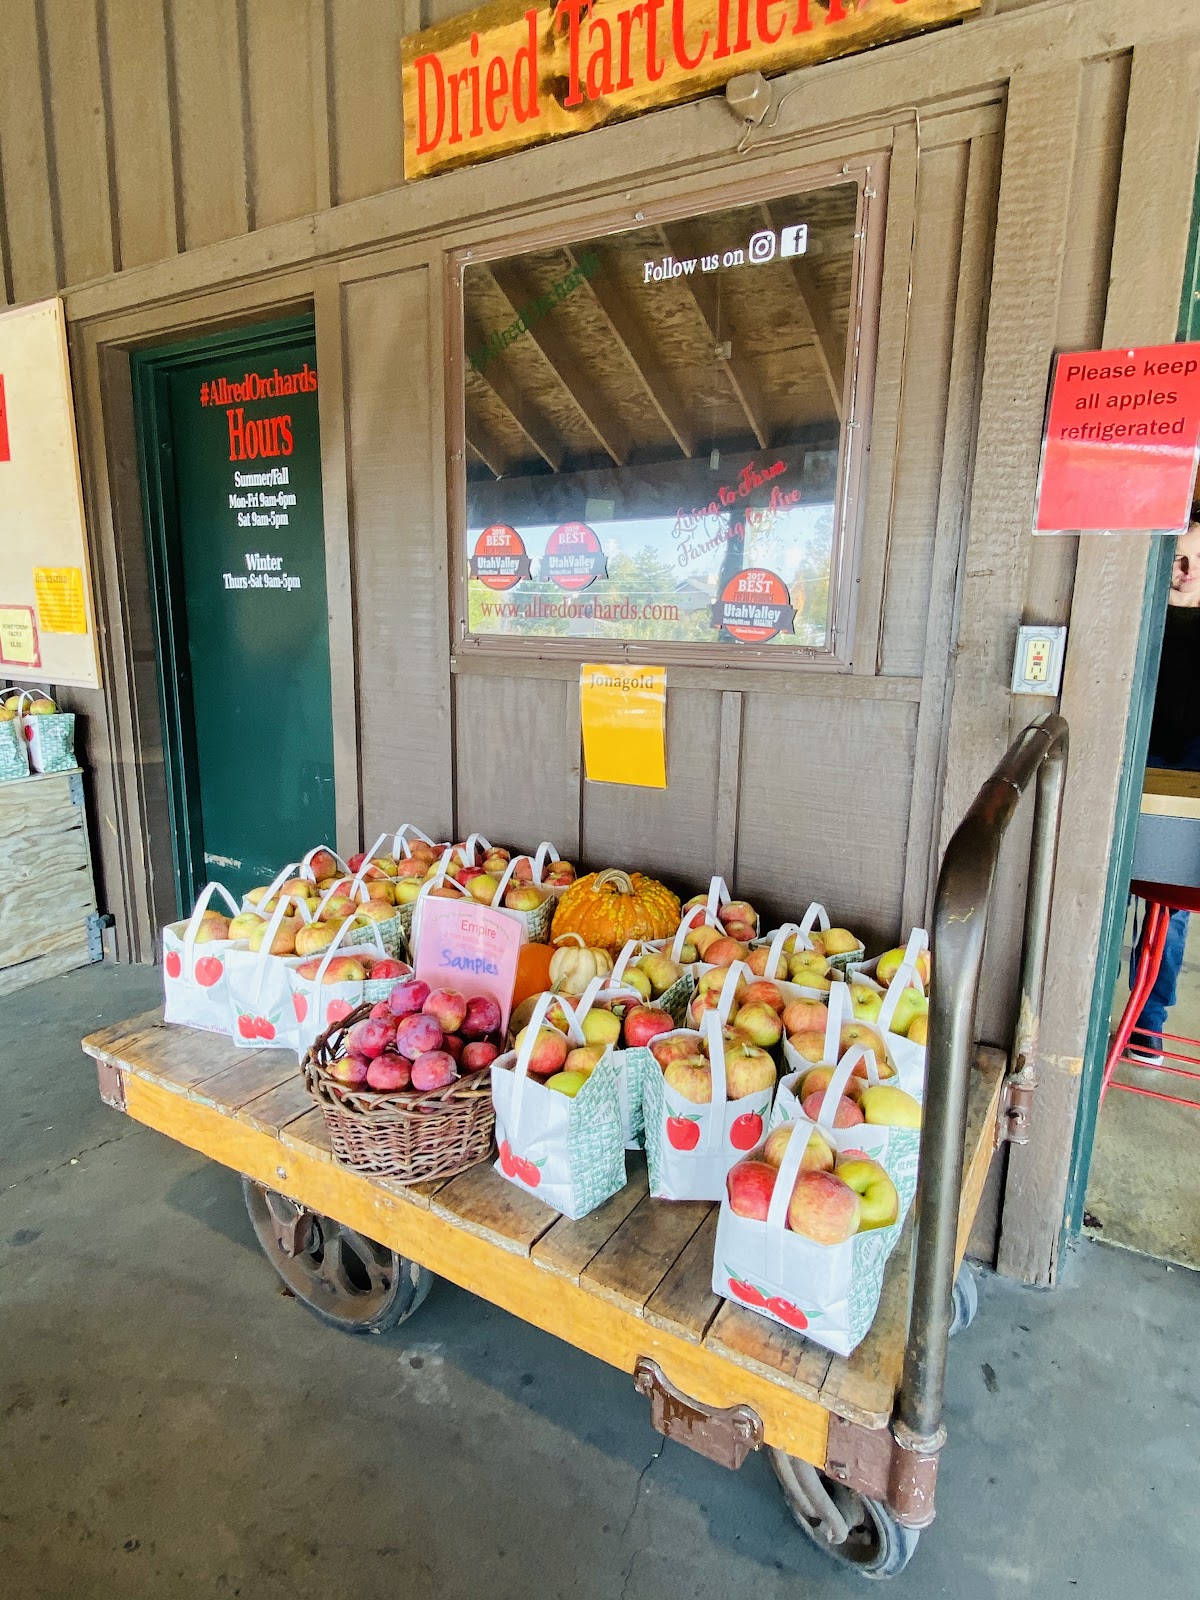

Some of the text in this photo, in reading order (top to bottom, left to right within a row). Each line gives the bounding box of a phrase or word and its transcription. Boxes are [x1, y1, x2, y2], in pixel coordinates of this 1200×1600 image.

[416, 9, 539, 156] Dried
[558, 0, 665, 107] Tart
[644, 257, 697, 283] Follow
[702, 254, 718, 271] us
[724, 249, 744, 267] on
[1067, 359, 1198, 381] Please keep
[201, 363, 317, 407] #AllredOrchards
[1076, 389, 1177, 410] all apples
[227, 408, 293, 461] Hours
[1061, 417, 1185, 441] refrigerated
[235, 467, 289, 487] Summer/Fall
[718, 486, 737, 506] to
[739, 460, 787, 497] Farm
[229, 491, 297, 509] Mon-Fri 9am-6pm
[238, 511, 289, 529] Sat 9am-5pm
[485, 534, 513, 547] BEST
[558, 531, 587, 544] BEST
[678, 522, 745, 567] Farming
[745, 507, 764, 526] to
[245, 553, 283, 571] Winter
[478, 557, 520, 571] UtahValley
[549, 556, 595, 569] UtahValley
[264, 573, 301, 592] 9am-5pm
[738, 580, 773, 593] BEST
[746, 572, 767, 582] 2017
[481, 595, 679, 620] www.allredorchards.com
[724, 604, 781, 623] UtahValley
[591, 672, 654, 691] Jonagold
[461, 920, 496, 939] Empire
[439, 948, 498, 975] Samples
